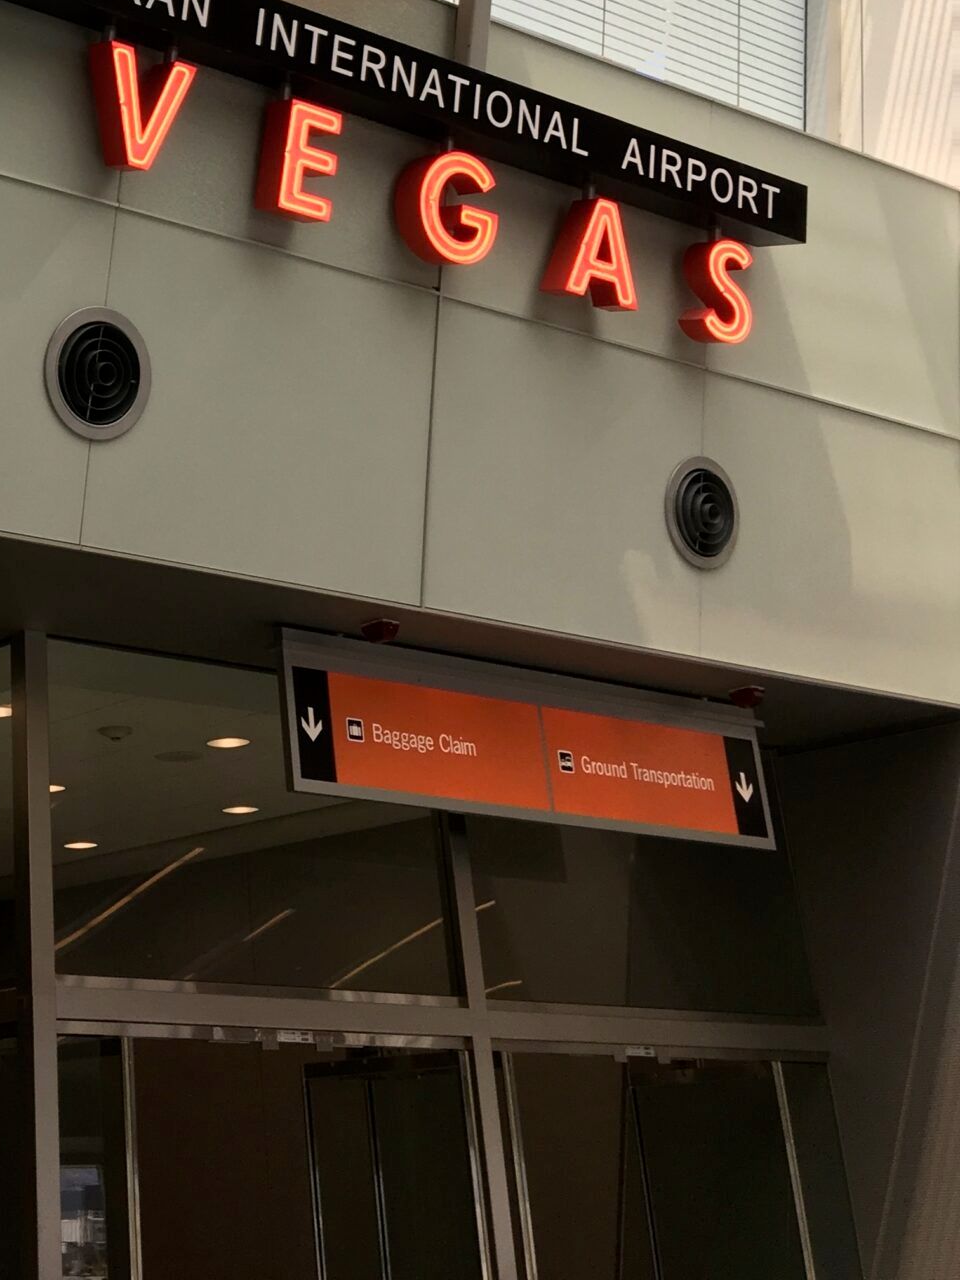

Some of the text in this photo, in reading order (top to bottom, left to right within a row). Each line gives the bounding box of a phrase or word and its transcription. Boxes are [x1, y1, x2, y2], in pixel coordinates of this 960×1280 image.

[255, 7, 590, 158] INTERNATIONAL
[621, 143, 782, 221] AIRPORT
[91, 40, 756, 345] VEGAS
[373, 723, 477, 757] Baggage Claim
[581, 755, 715, 792] Ground Transportation
